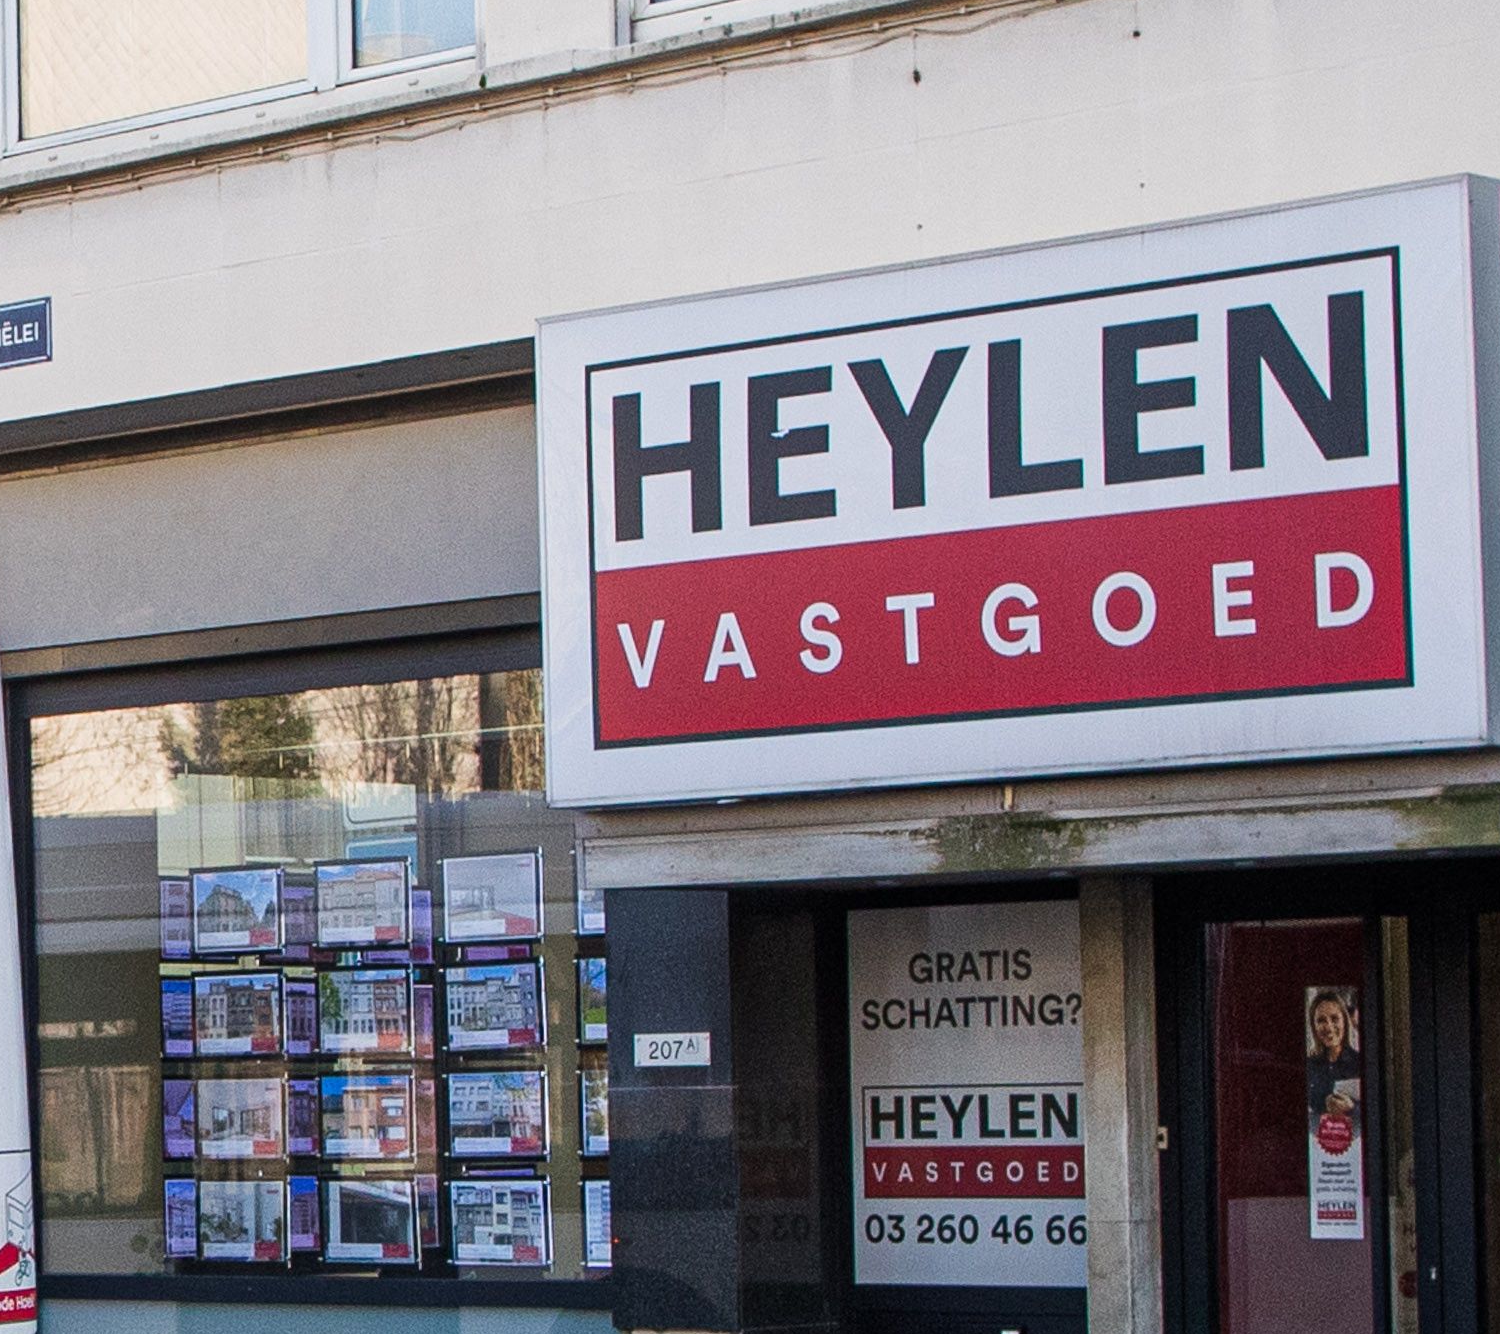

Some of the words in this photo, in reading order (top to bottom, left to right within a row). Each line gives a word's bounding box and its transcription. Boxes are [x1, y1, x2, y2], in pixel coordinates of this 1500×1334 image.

[611, 289, 1370, 543] HEYLEN
[616, 551, 1375, 689] VASTGOED
[907, 948, 1033, 984] GRATIS
[861, 992, 1083, 1030] SCHATTING?
[869, 1091, 1079, 1140] HEYLEN
[872, 1160, 1080, 1183] VASTGOED
[864, 1213, 906, 1244] 03
[916, 1213, 979, 1245] 260
[990, 1214, 1034, 1245] 46
[1045, 1214, 1088, 1245] 66
